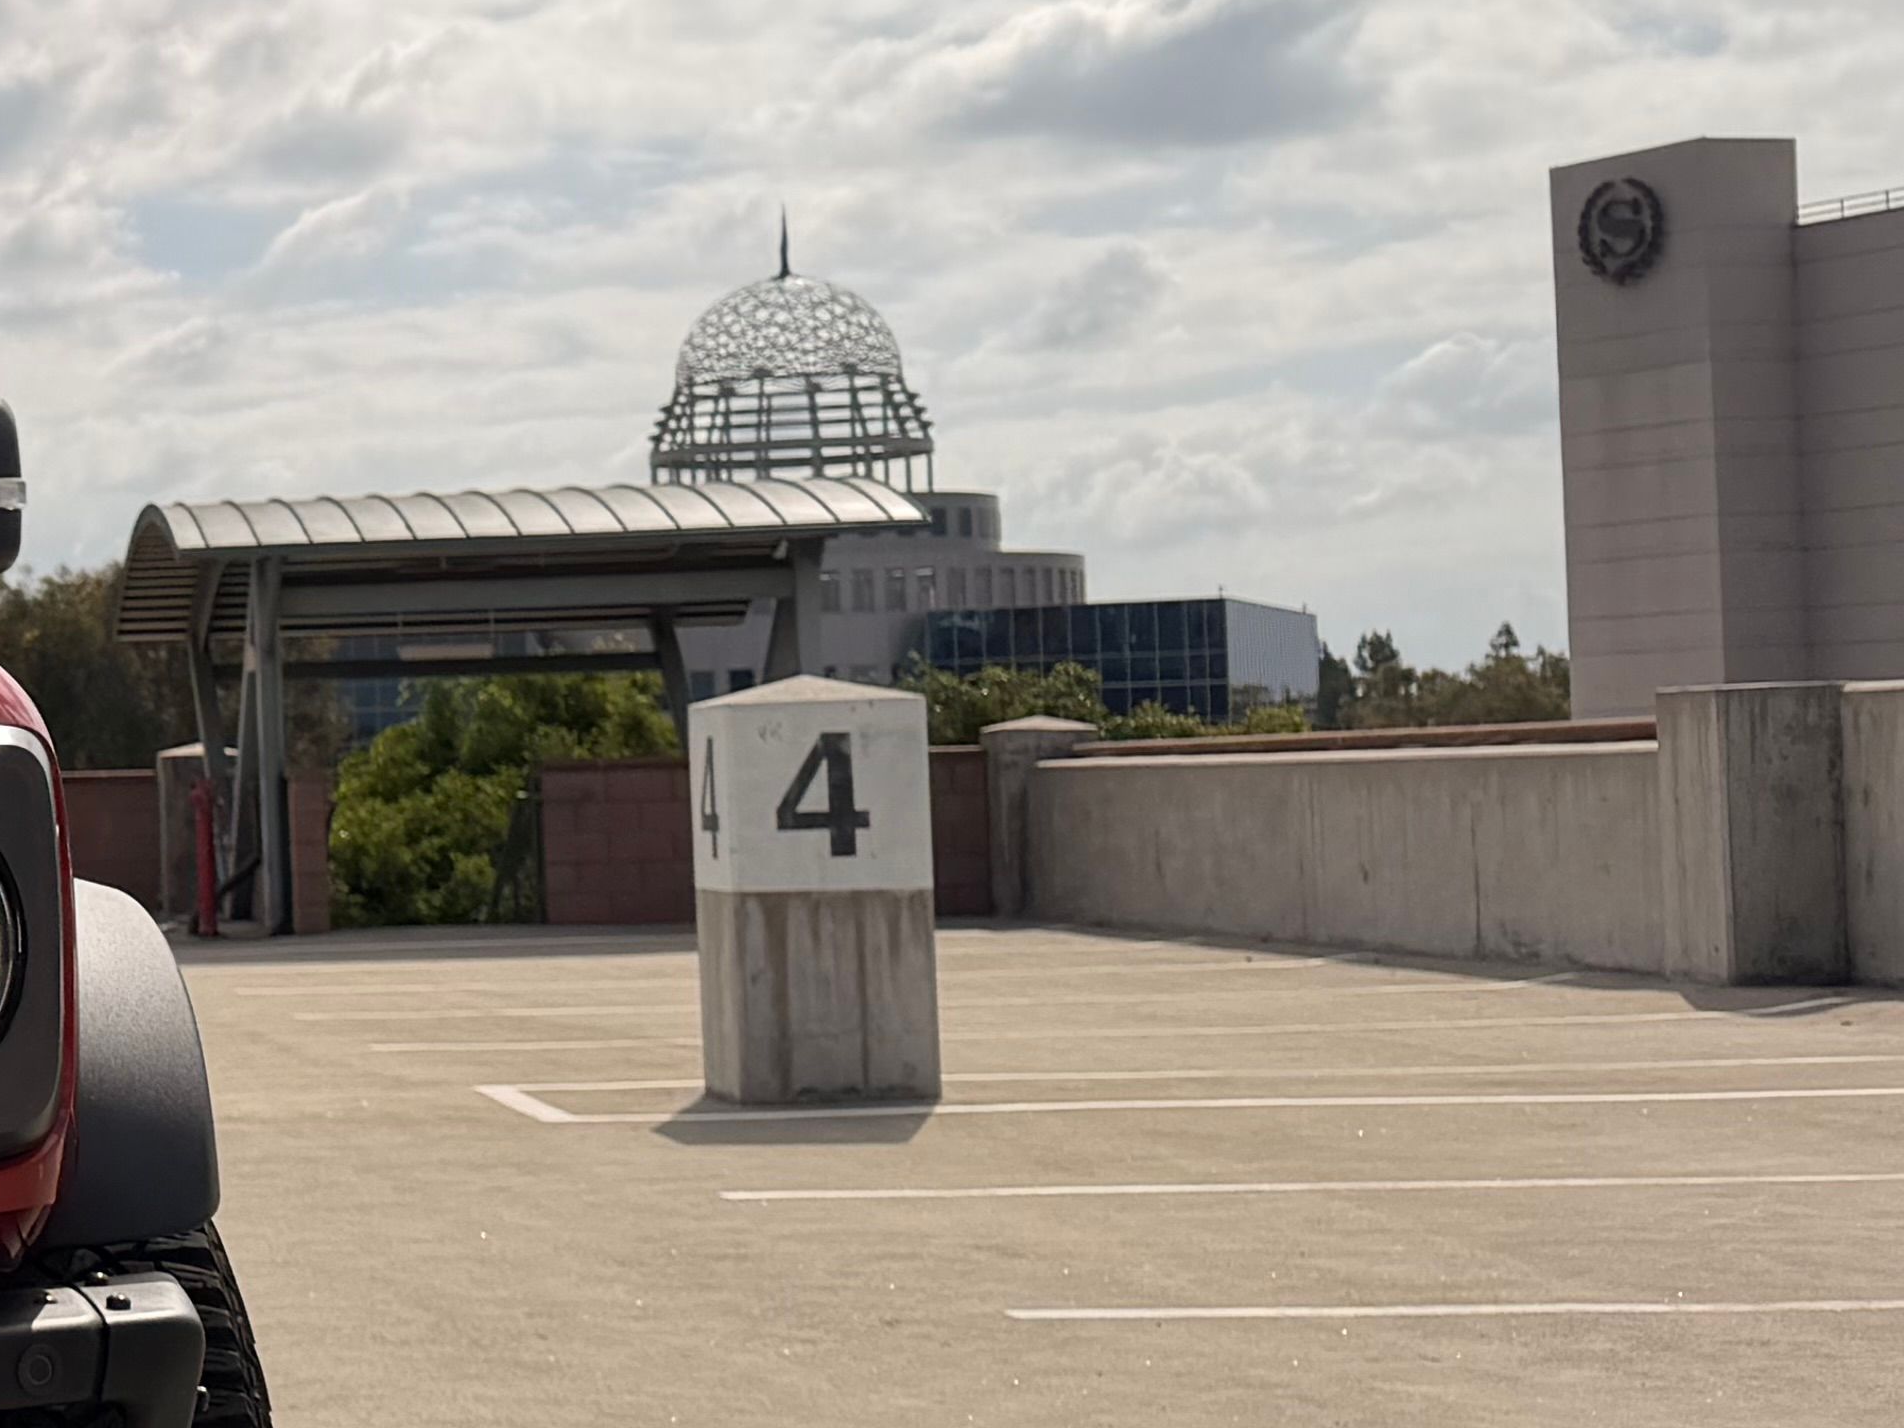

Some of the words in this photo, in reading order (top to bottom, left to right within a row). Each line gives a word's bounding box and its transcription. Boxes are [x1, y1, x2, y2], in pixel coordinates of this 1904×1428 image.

[1597, 197, 1647, 258] S
[701, 736, 719, 859] 4
[776, 732, 870, 857] 4
